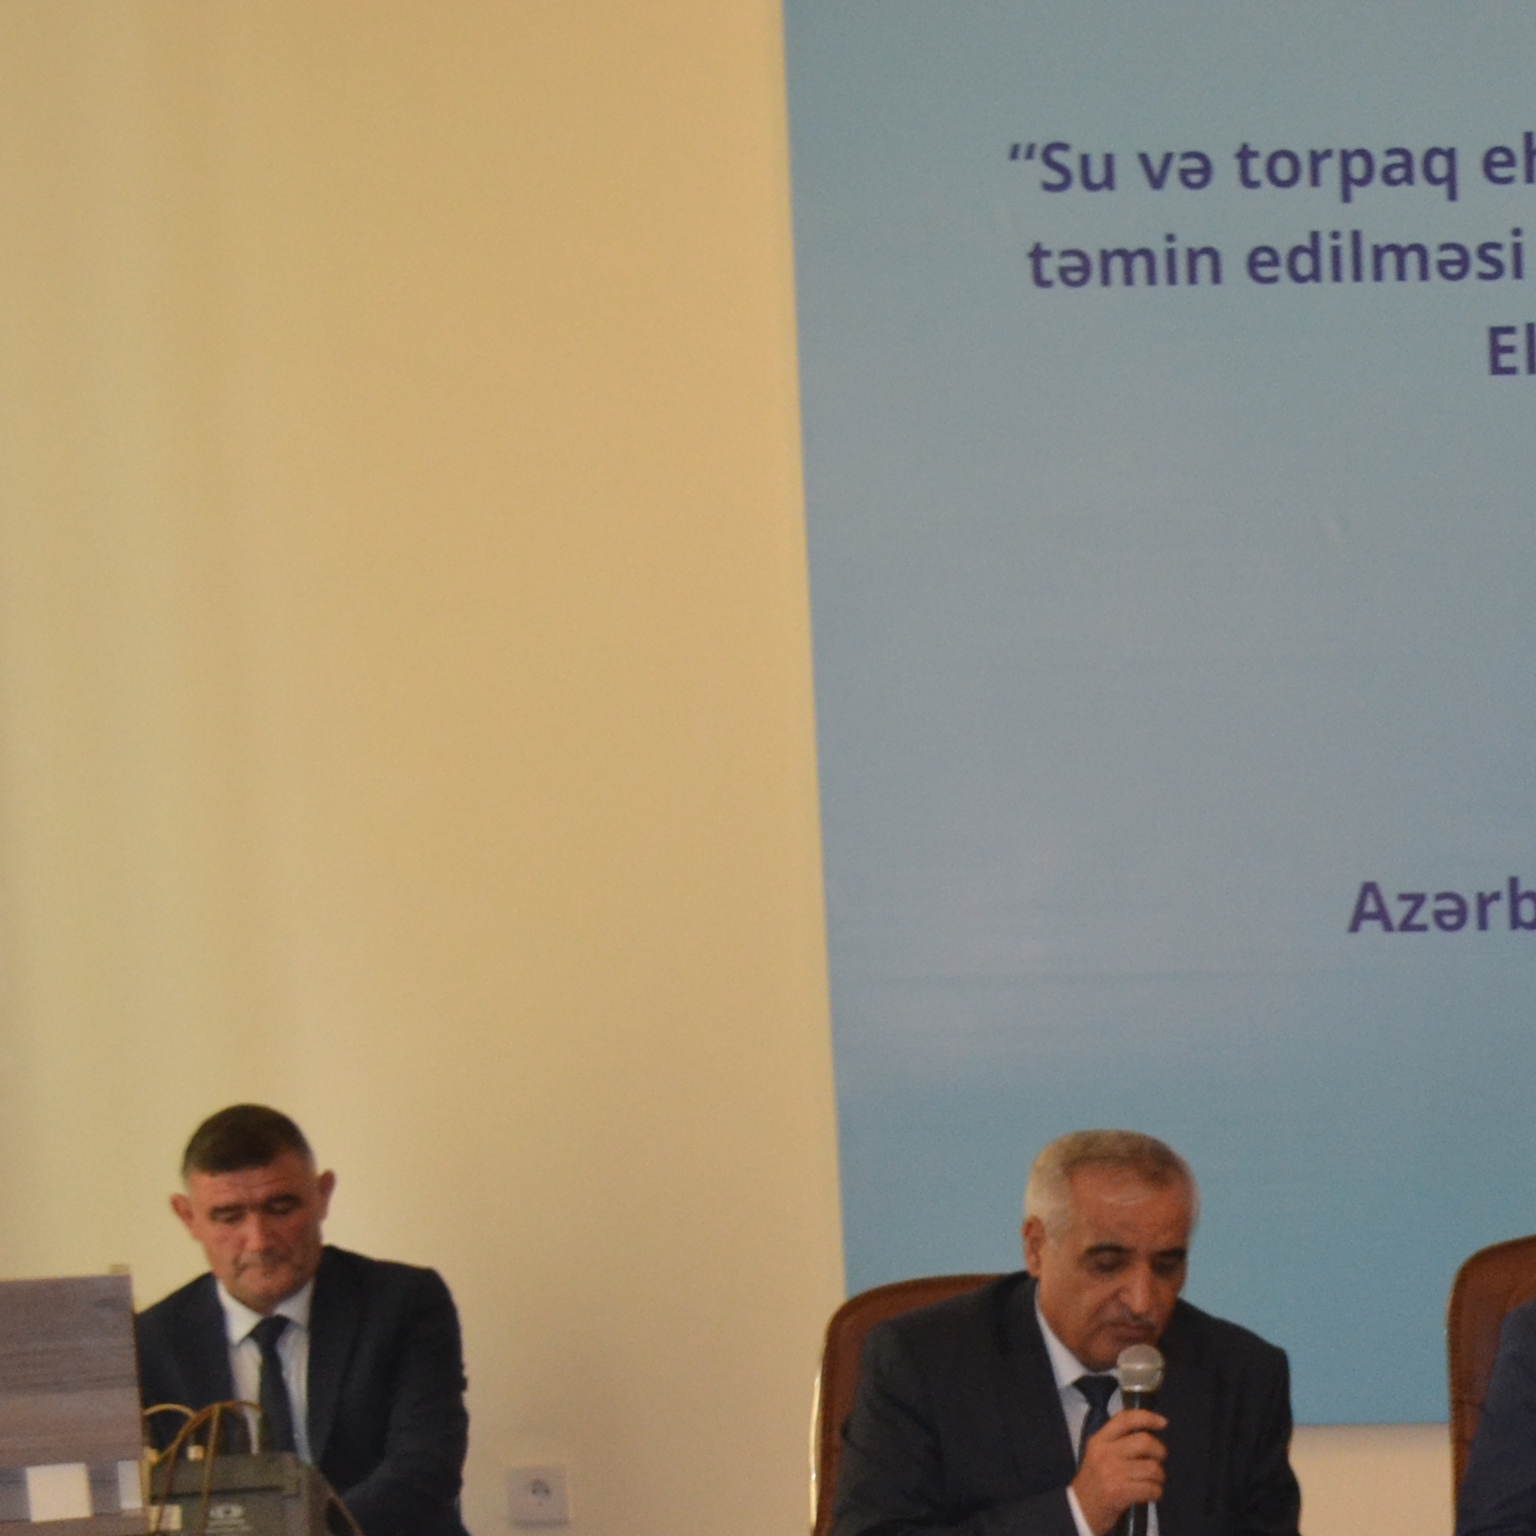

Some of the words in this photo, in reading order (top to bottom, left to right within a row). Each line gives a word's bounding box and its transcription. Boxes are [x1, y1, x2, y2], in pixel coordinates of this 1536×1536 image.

[1008, 140, 1117, 194] “Su
[1137, 150, 1215, 192] və
[1233, 141, 1459, 205] torpaq
[1025, 232, 1224, 290] təmin
[1244, 226, 1525, 286] edilməsi
